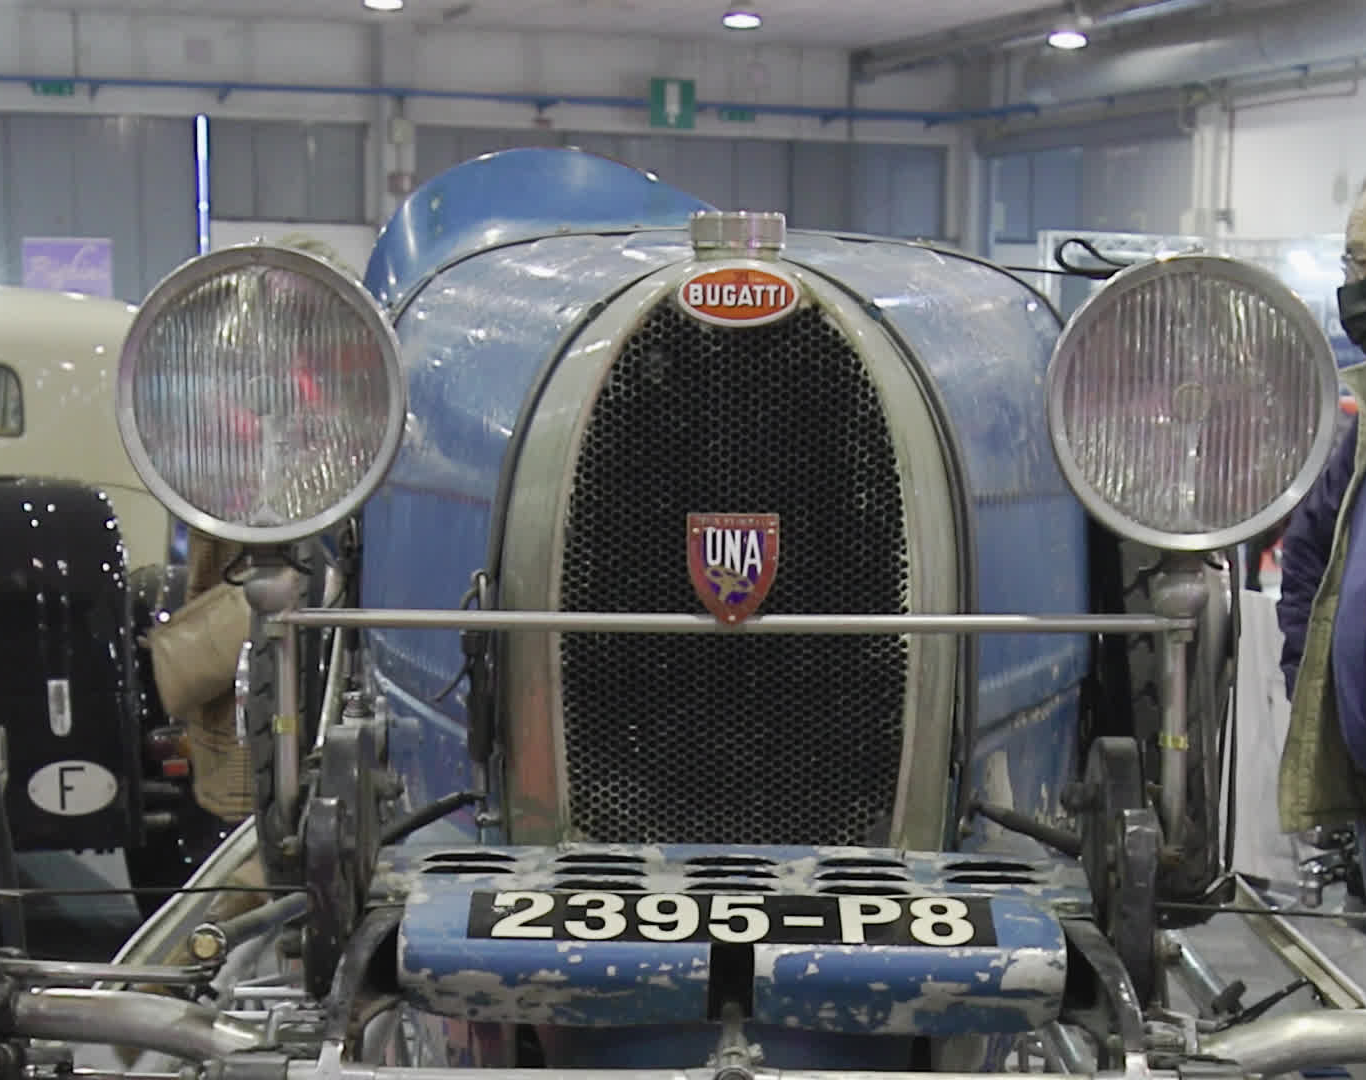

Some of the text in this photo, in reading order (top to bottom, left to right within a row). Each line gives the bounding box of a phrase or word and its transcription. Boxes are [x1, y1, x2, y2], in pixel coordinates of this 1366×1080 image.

[689, 283, 786, 307] BUGATTI
[705, 527, 763, 578] UNA
[58, 766, 84, 811] F
[491, 892, 975, 947] 2395-P8
